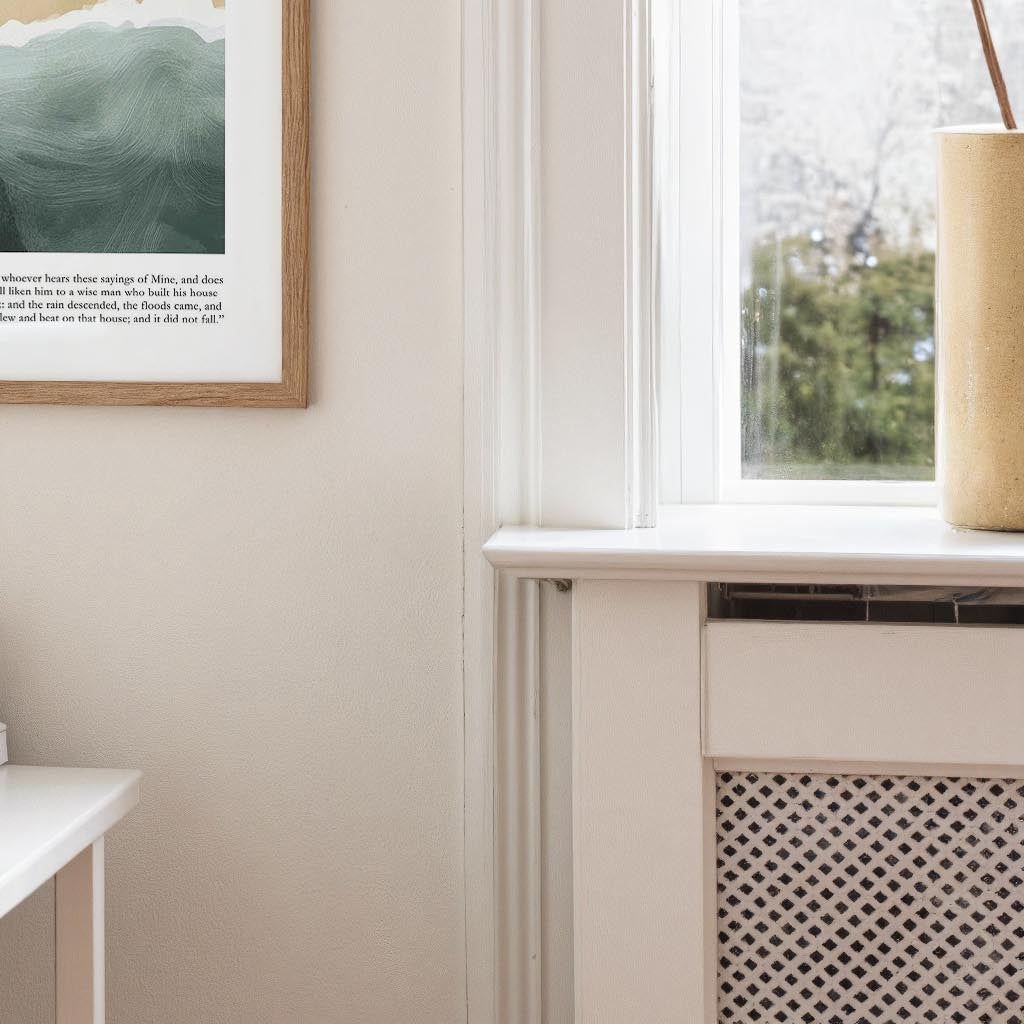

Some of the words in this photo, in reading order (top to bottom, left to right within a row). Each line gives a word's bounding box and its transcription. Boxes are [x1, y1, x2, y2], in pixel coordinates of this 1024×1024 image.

[0, 272, 43, 284] whoever
[44, 273, 71, 284] hears
[72, 273, 98, 284] these
[98, 273, 135, 286] sayings
[137, 273, 150, 284] of
[150, 273, 179, 286] Mine,
[180, 273, 199, 285] and
[200, 274, 224, 285] does
[8, 286, 32, 296] liken
[34, 286, 54, 296] him
[55, 288, 67, 296] to
[68, 288, 75, 297] a
[76, 286, 98, 297] wise
[100, 288, 122, 297] man
[124, 287, 146, 297] who
[147, 287, 171, 297] built
[172, 287, 188, 297] his
[189, 287, 219, 298] house
[7, 299, 26, 310] and
[27, 299, 44, 310] the
[45, 299, 65, 310] rain
[66, 299, 120, 312] descended,
[122, 300, 139, 311] the
[140, 300, 172, 311] floods
[173, 303, 203, 313] came,
[203, 301, 223, 312] and
[18, 312, 37, 323] and
[38, 312, 60, 323] beat
[61, 315, 76, 323] on
[77, 312, 97, 323] that
[99, 312, 131, 325] house;
[132, 313, 151, 324] and
[153, 313, 162, 324] it
[163, 313, 179, 324] did
[181, 316, 199, 324] not
